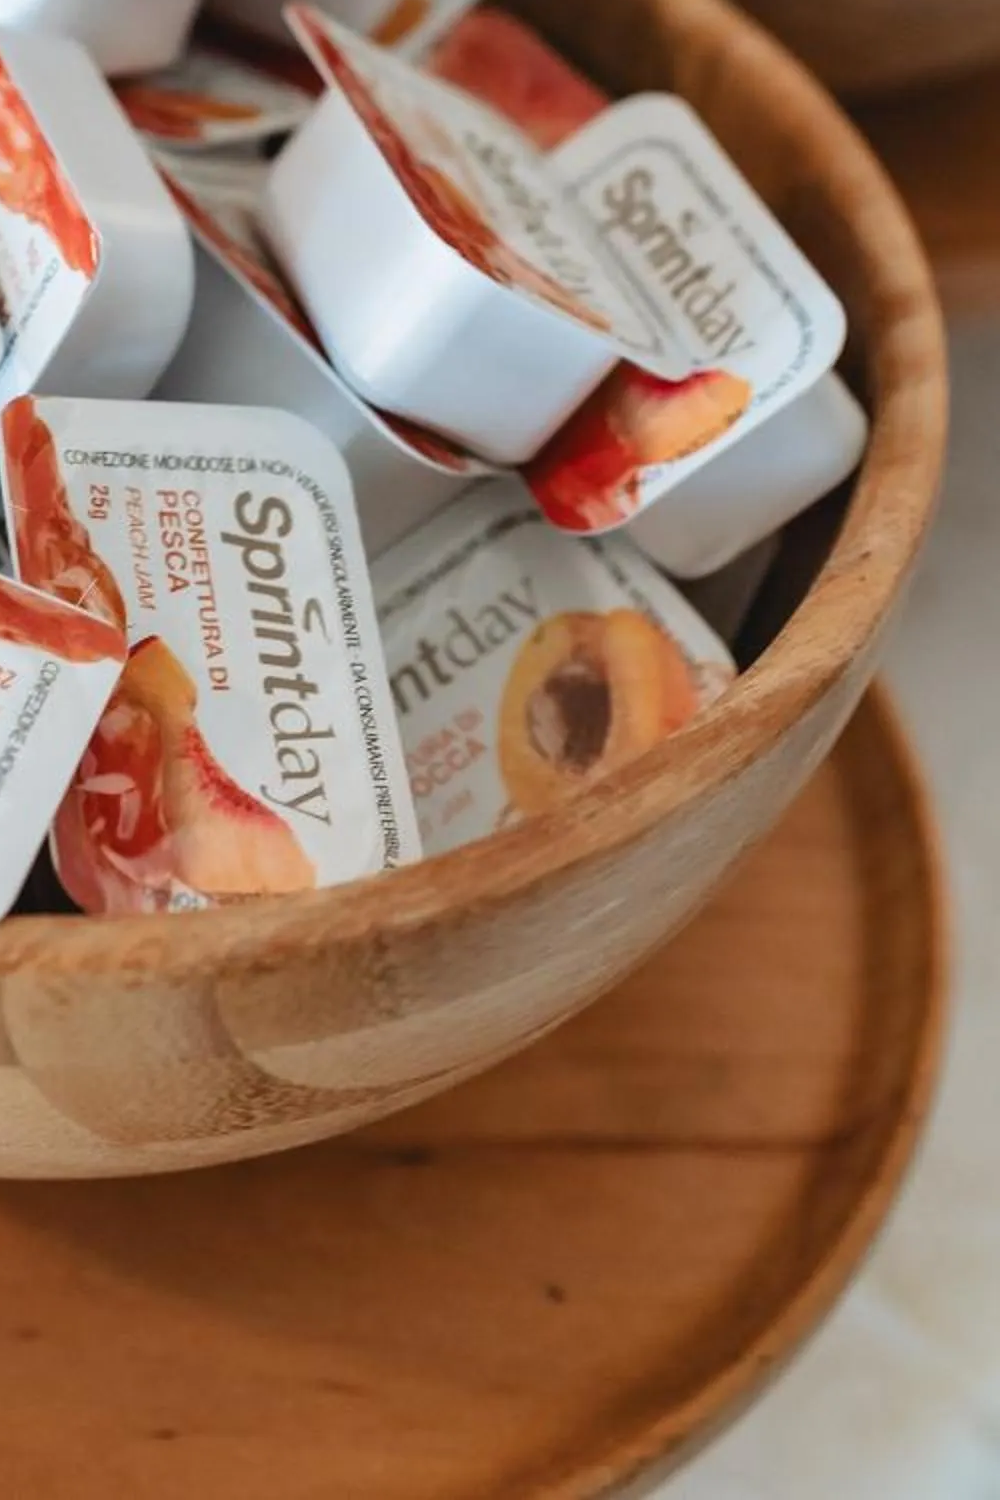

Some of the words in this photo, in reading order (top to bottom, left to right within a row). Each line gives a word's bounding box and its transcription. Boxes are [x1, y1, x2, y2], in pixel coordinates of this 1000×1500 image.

[599, 165, 755, 358] Sprintday
[63, 449, 150, 469] CONFEZIONE
[152, 454, 235, 473] MONODOSE
[237, 458, 257, 474] DA
[87, 484, 109, 521] 25g
[124, 486, 149, 561] PEACH
[156, 489, 190, 593] PESCA
[131, 563, 156, 611] JAM
[181, 489, 225, 660] CONFETTURA
[208, 666, 230, 691] DI
[220, 490, 336, 826] Sprintday
[350, 662, 368, 684] DA
[389, 575, 546, 715] ntday
[355, 685, 389, 787] CONSUMARSI
[374, 785, 400, 869] PREFERIBIL
